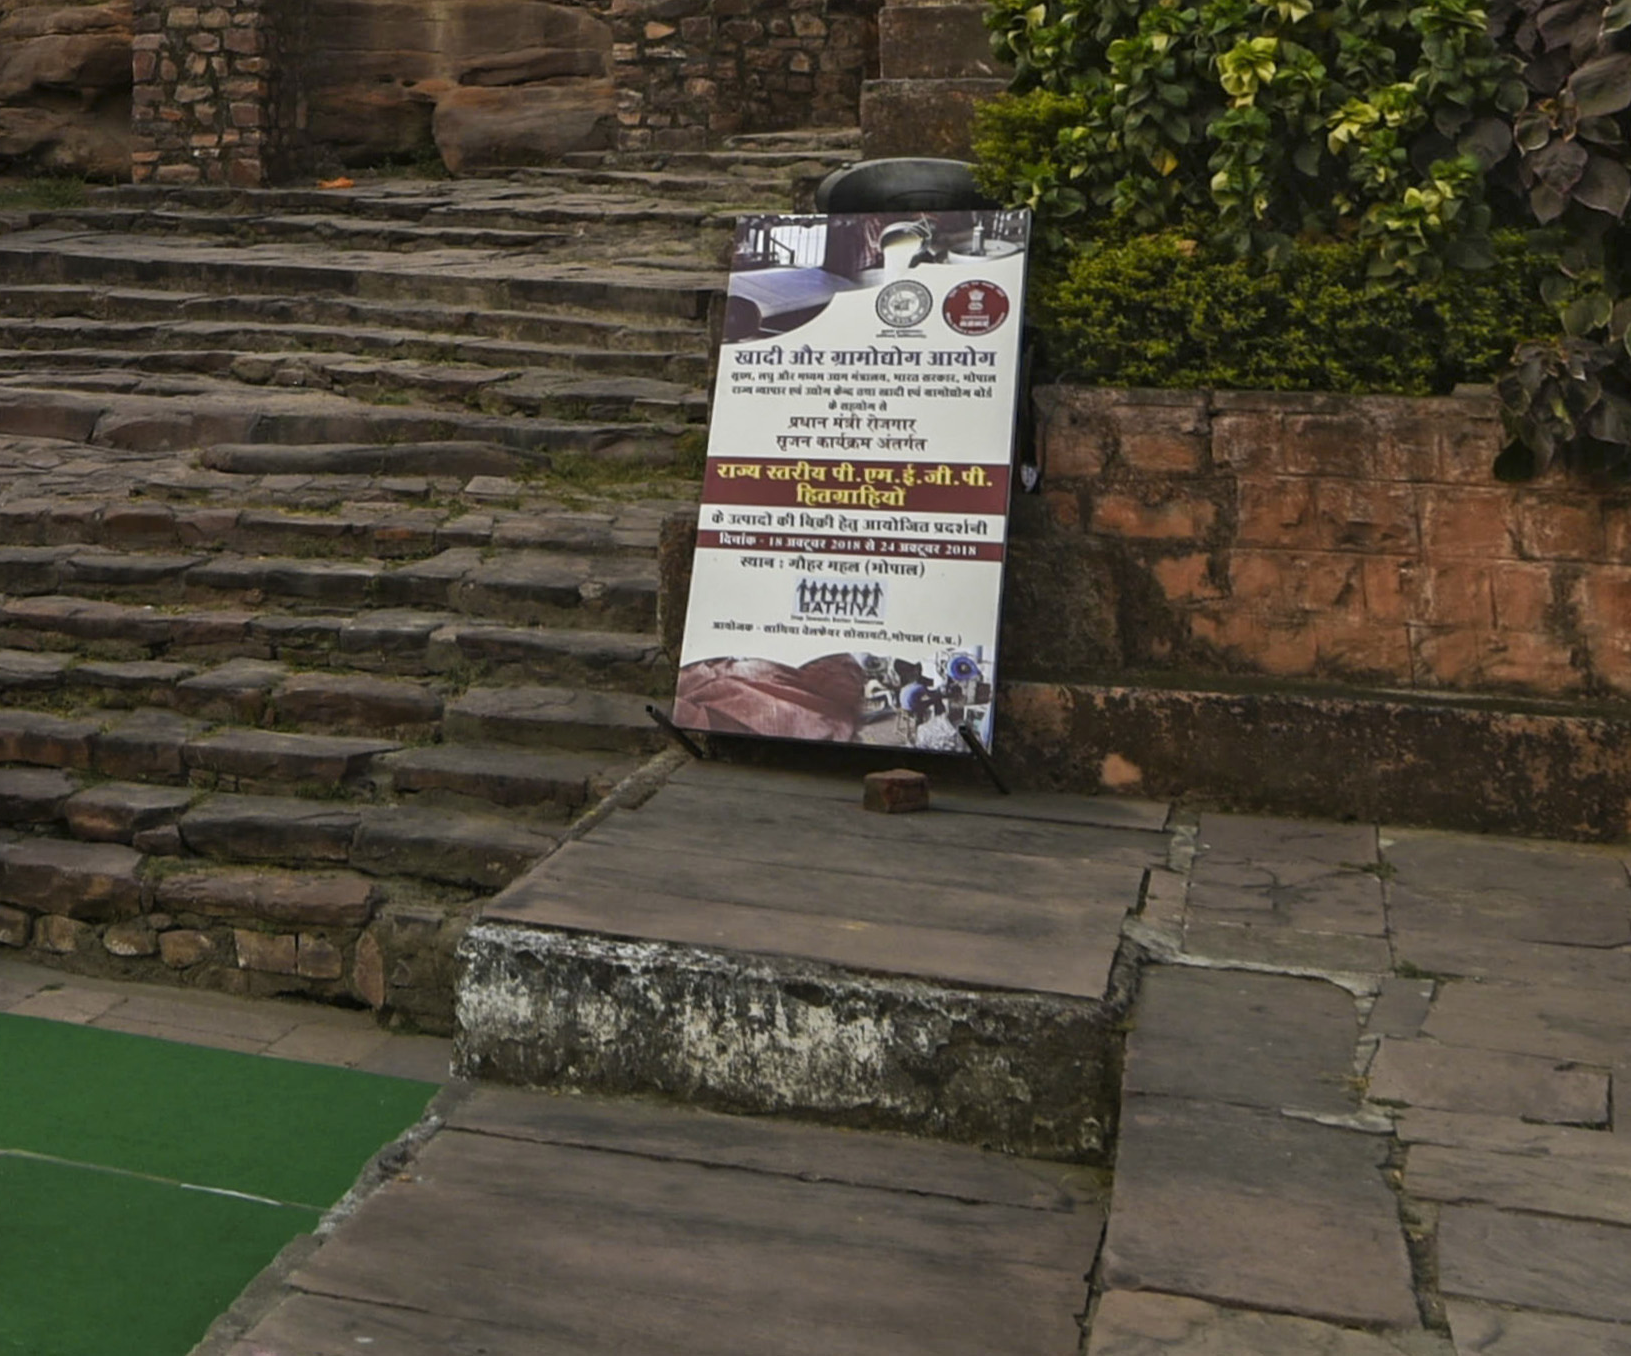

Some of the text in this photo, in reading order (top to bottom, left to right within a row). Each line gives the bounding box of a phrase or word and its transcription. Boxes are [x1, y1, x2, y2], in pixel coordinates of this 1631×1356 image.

[735, 344, 997, 367] खादी और ग्रामोद्योग आयोग
[788, 413, 917, 434] प्रधान मंत्री रोजगार
[776, 432, 928, 452] सृजन कार्यक्रम अंतर्गत
[717, 463, 762, 479] राज्य
[765, 460, 827, 482] स्तरीय
[796, 482, 906, 509] हितग्राहियों
[711, 509, 724, 524] के
[777, 511, 795, 527] की
[862, 516, 930, 533] आयोजित
[933, 518, 988, 535] प्रदर्शनी
[830, 539, 861, 550] 2018
[880, 541, 895, 552] 24
[944, 544, 977, 556] 2018
[740, 555, 775, 568] स्थान
[788, 555, 823, 573] गौहर
[828, 560, 860, 574] महल
[864, 559, 925, 578] (भोपाल)
